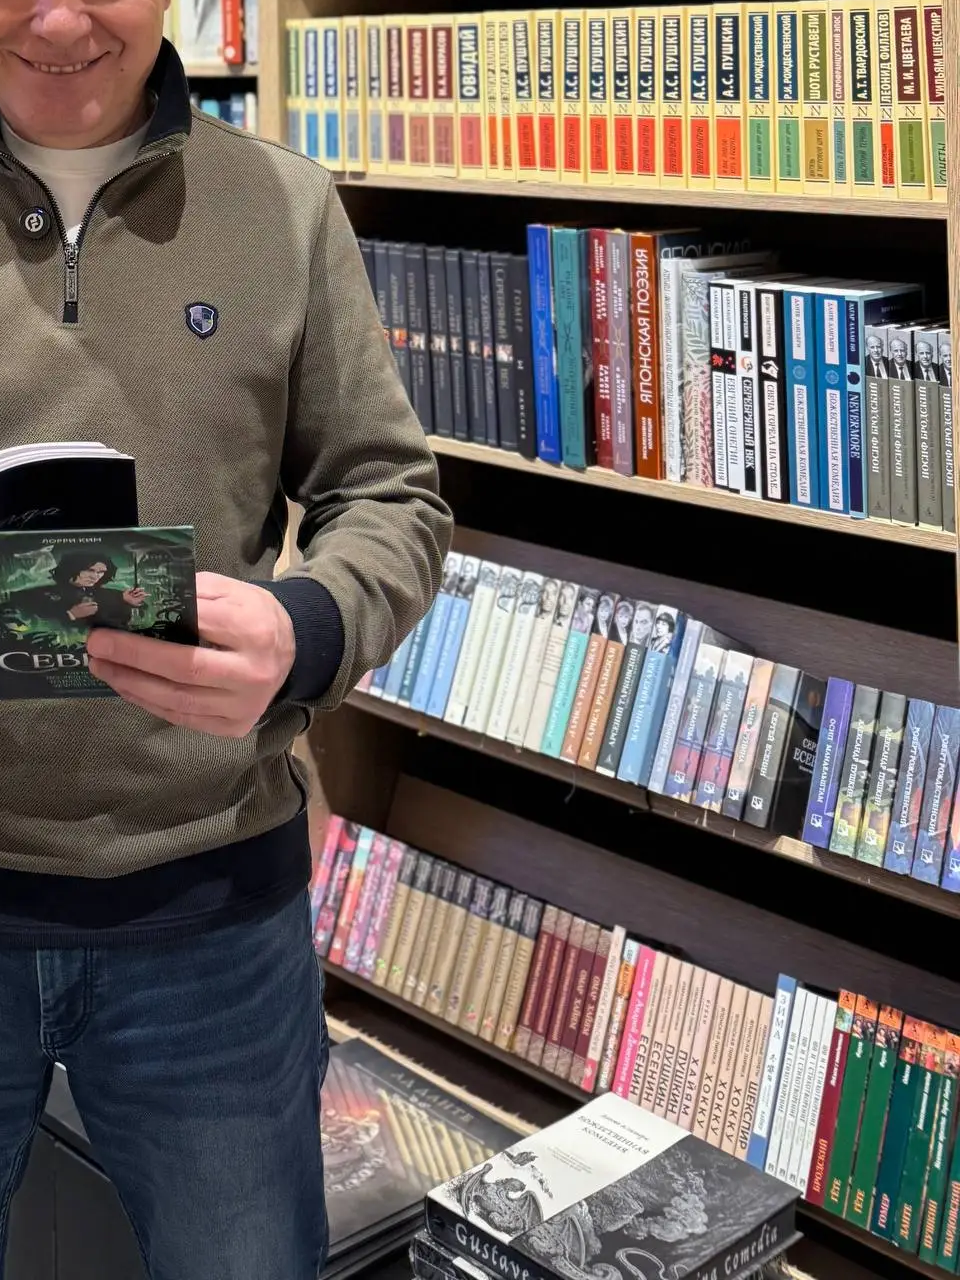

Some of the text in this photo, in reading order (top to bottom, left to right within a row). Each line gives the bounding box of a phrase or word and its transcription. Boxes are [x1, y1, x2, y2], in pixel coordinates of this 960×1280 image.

[460, 29, 477, 96] ОВИДИЙ
[516, 23, 530, 98] А.С. ПУШКИН
[540, 23, 552, 98] А.С. ПУШКИН
[566, 22, 579, 98] А.С. ПУШКИН
[591, 22, 604, 99] А.С. ПУШКИН
[615, 20, 629, 99] А.С. ПУШКИН
[640, 20, 653, 99] А.С. ПУШКИН
[665, 19, 679, 99] А.С. ПУШКИН
[692, 19, 706, 99] А.С. ПУШКИН
[721, 18, 734, 97] А.С. ПУШКИН
[753, 16, 764, 99] Р.И. РОЖДЕСТВЕНСКИЙ
[781, 15, 793, 99] Р.И. РОЖДЕСТВЕНСКИЙ
[808, 14, 820, 100] ШОТА РУСТАВЕЛИ
[854, 15, 867, 99] А. Т. ТВАРДОВСКИЙ
[879, 14, 891, 102] ЛЕОНИД ФИЛАТОВ
[901, 17, 915, 94] М. И. ЦВЕТАЕВА
[931, 12, 944, 97] УИЛЬЯМ ШЕКСПИР
[635, 248, 652, 405] ЯПОНСКАЯ ПОЭЗИЯ
[741, 292, 750, 339] СТИХОТВОРЕНИЯ
[726, 377, 739, 466] ЕВГЕНИЙ ОНЕГИН
[742, 379, 755, 470] СЕРЕБРЯНЫЙ ВЕК
[765, 384, 779, 495] СВЕЧА ГОРЕЛА НА СТОЛЕ...
[796, 387, 808, 498] БОЖЕСТВЕННАЯ КОМЕДИЯ
[828, 392, 840, 504] БОЖЕСТВЕННАЯ КОМЕДИЯ
[848, 392, 860, 458] NEVERMORE
[869, 382, 880, 473] ИОСИФ БРОДСКИЙ
[892, 385, 902, 477] ИОСИФ БРОДСКИЙ
[919, 386, 929, 479] ИОСИФ БРОДСКИЙ
[943, 393, 954, 487] ИОСИФ БРОДСКИЙ
[606, 647, 639, 748] АРСЕНИЙ ТАРКОВСКИЙ
[759, 711, 780, 777] СЕРГЕЙ ЕСЕНИН
[815, 717, 836, 803] ОСИП МАНДЕЛЬШТАМ
[845, 719, 866, 798] АЛЕКСАНДР ПУШКИН
[872, 726, 894, 806] АЛЕКСАНДР ПУШКИН
[898, 726, 921, 829] РОБЕРТ РОЖДЕСТВЕНСКИЙ
[926, 733, 950, 837] РОБЕРТ РОЖДЕСТВЕНСКИЙ
[628, 997, 644, 1034] Андрей
[628, 1034, 649, 1096] ЕСЕНИН
[642, 1040, 663, 1103] ЕСЕНИН
[654, 1043, 675, 1108] ПУШКИН
[666, 1049, 688, 1115] ПУШКИН
[679, 1056, 700, 1117] ХАЙЯМ
[695, 1072, 713, 1129] ХОККУ
[580, 1125, 628, 1154] КОМЕДИЯ
[709, 1079, 727, 1136] ХОККУ
[723, 1085, 742, 1143] ХОККУ
[737, 1080, 758, 1150] ШЕКСПИР
[810, 1137, 828, 1192] БРОДСКИЙ
[829, 1176, 842, 1202] ГЁТЕ
[852, 1187, 866, 1213] ГЁТЕ
[899, 1202, 912, 1239] ДАНТЕ
[923, 1198, 938, 1248] ПУШКИН
[942, 1180, 960, 1257] ТВАРДОВСКИЙ
